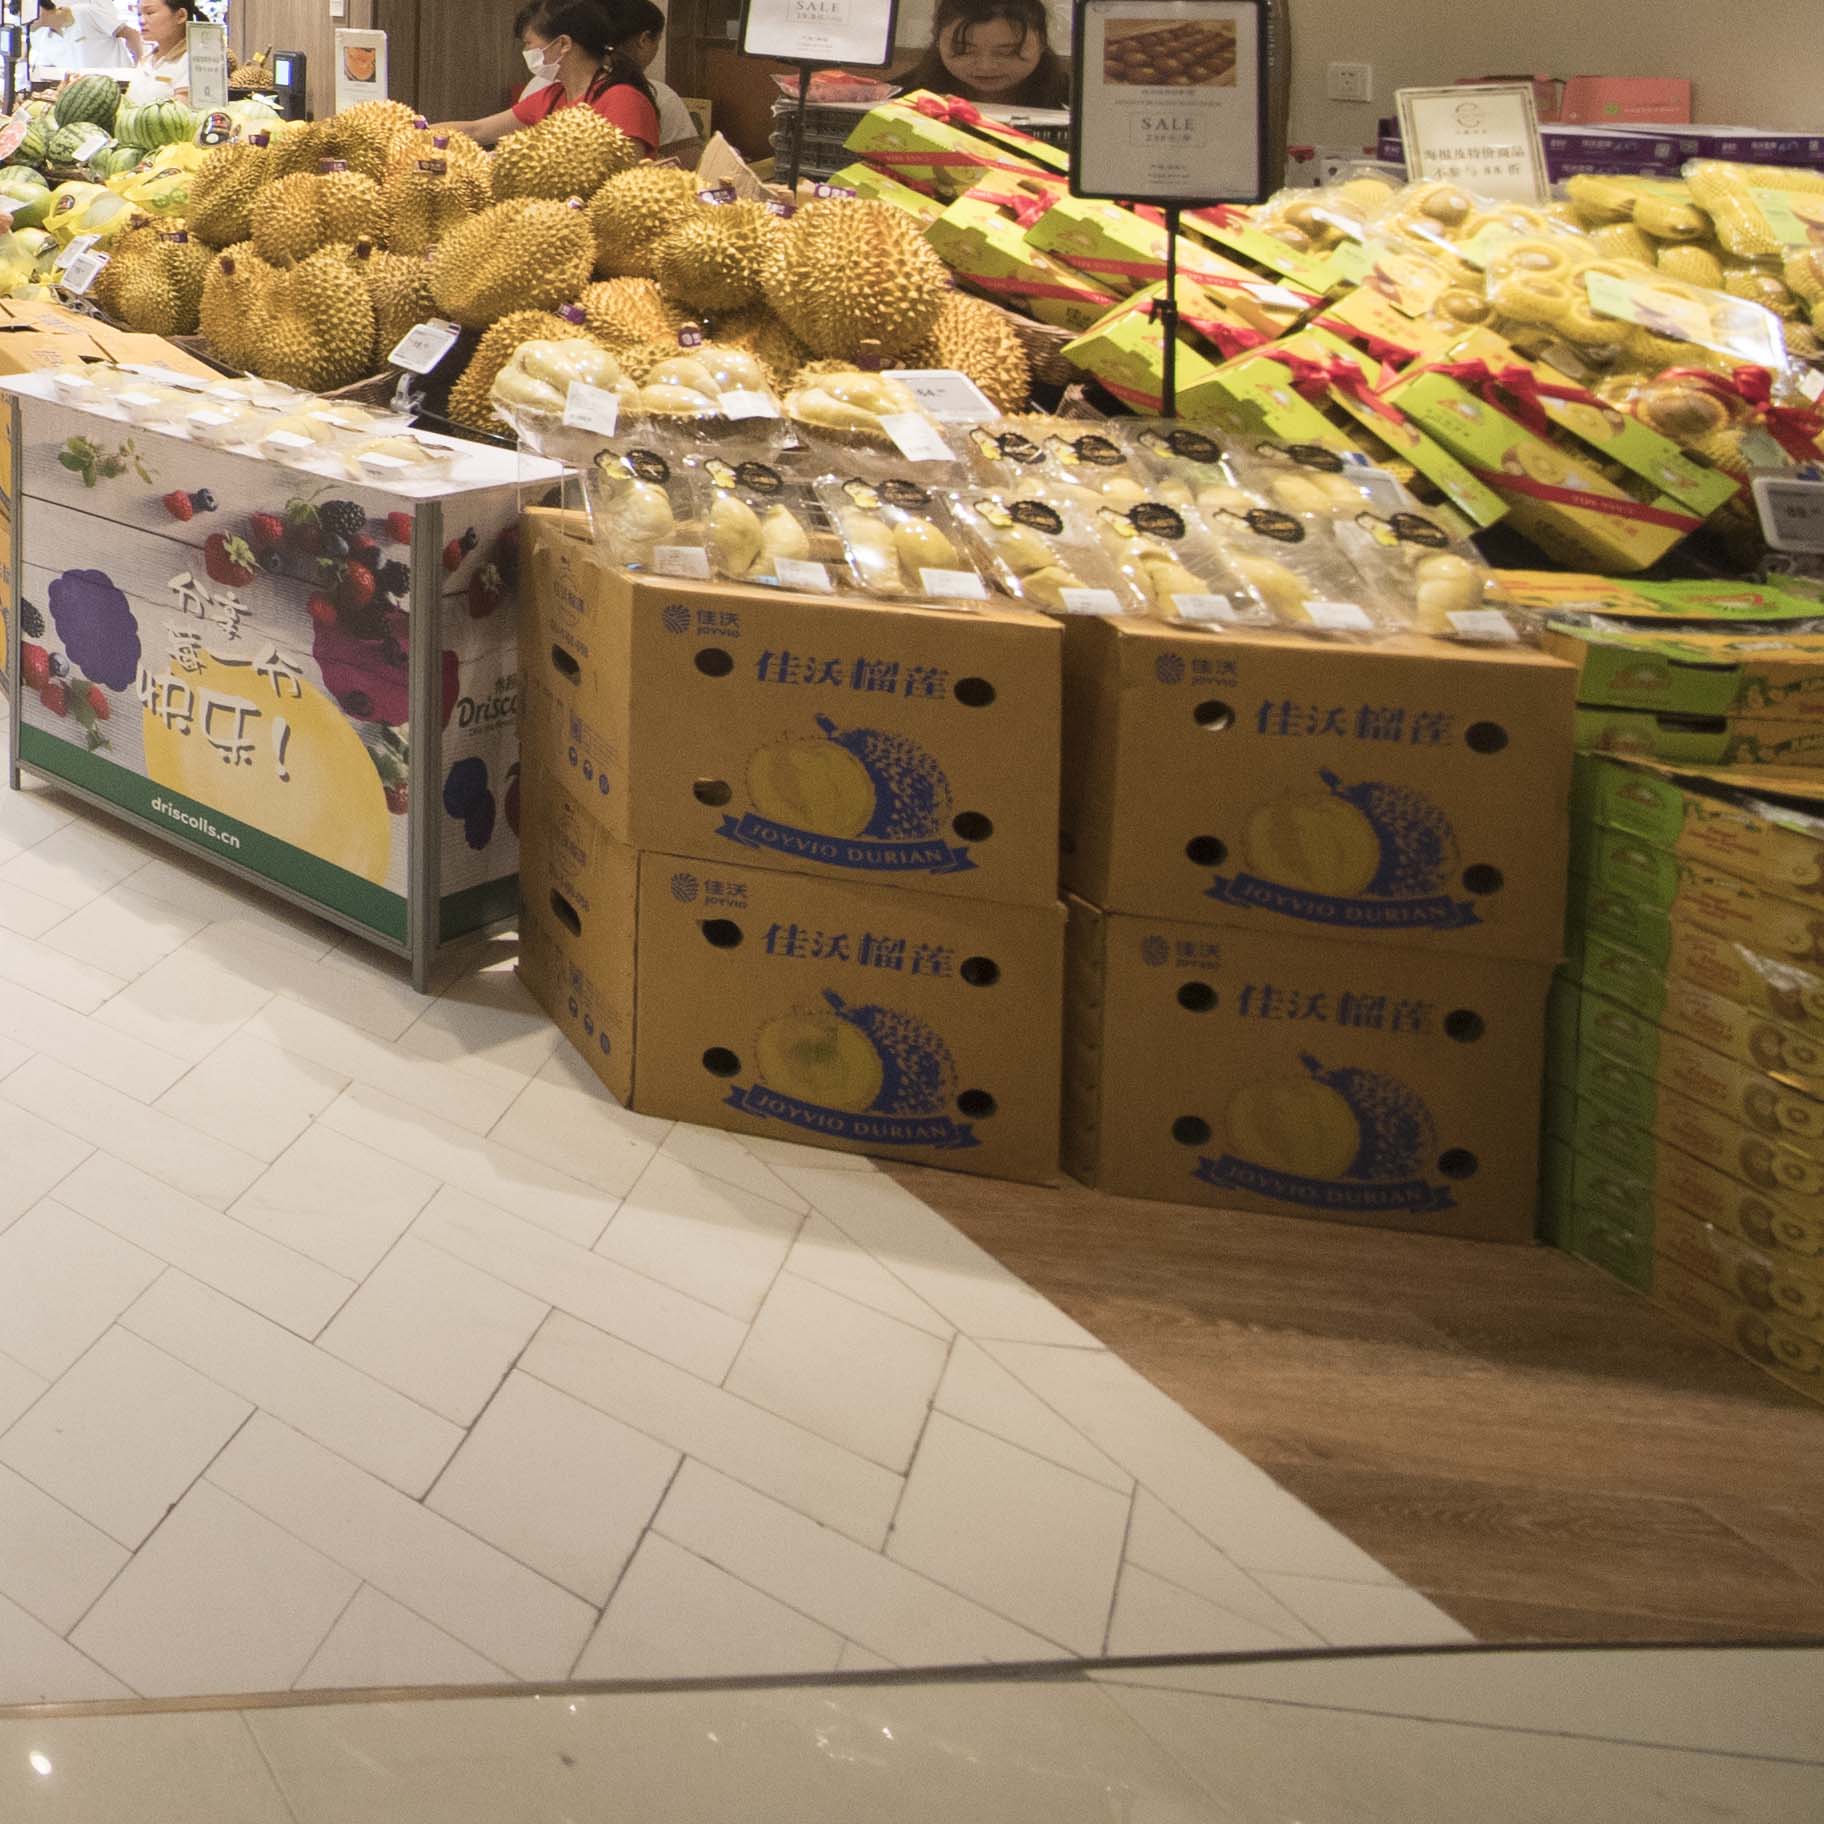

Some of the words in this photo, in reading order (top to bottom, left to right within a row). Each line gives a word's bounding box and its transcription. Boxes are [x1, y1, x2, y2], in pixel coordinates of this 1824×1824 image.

[795, 0, 841, 14] SALE
[1140, 117, 1195, 131] SALE
[696, 608, 741, 626] 佳沃
[755, 649, 952, 700] 佳沃榴莲
[1257, 698, 1454, 745] 佳沃榴莲
[151, 794, 242, 851] driscolls.cn
[751, 825, 839, 859] JOYVIO
[847, 845, 944, 865] DURIAN
[704, 879, 748, 897] 佳沃
[762, 922, 955, 976] 佳沃榴莲
[1237, 982, 1438, 1031] 佳沃榴莲
[756, 1092, 845, 1131] JOYVIO
[853, 1120, 950, 1139] DURIAN
